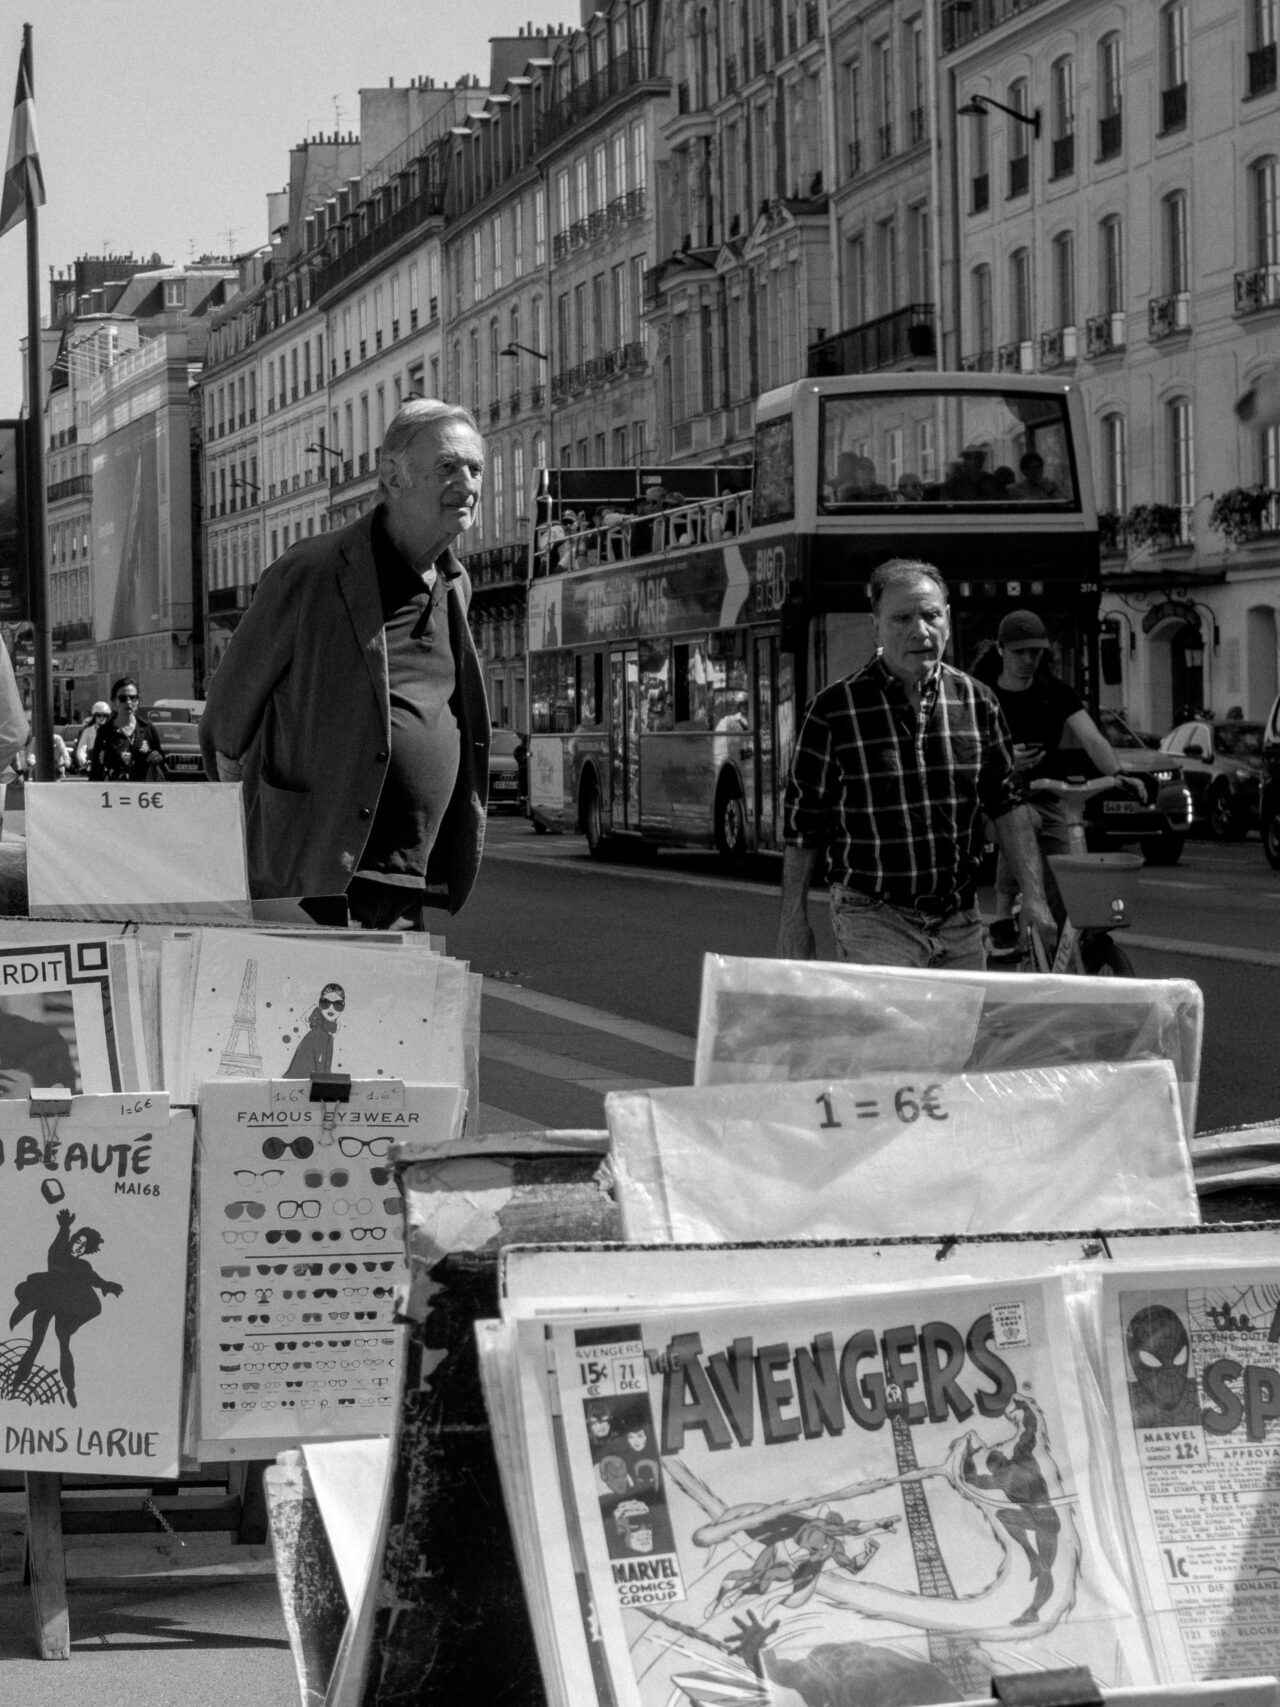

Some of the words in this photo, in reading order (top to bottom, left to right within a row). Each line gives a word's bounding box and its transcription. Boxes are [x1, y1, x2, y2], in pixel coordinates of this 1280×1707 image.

[1080, 583, 1098, 593] 374
[631, 577, 668, 629] PARIS
[101, 791, 113, 808] 1
[138, 791, 164, 809] 6€
[815, 1092, 842, 1129] 1
[894, 1084, 949, 1124] 6€
[237, 1111, 312, 1123] FAMOUS
[14, 1132, 153, 1178] BEAUTÉ
[1206, 1301, 1256, 1332] the
[576, 1343, 642, 1359] AVENGERS
[645, 1347, 683, 1375] THE
[580, 1362, 608, 1386] 15¢
[619, 1363, 636, 1380] 71
[620, 1380, 642, 1391] DEC
[662, 1313, 1017, 1456] AVENGERS
[1201, 1358, 1280, 1443] SP
[5, 1426, 69, 1455] DANS
[1143, 1430, 1197, 1444] MARVEL
[1175, 1442, 1200, 1461] 12¢
[1223, 1447, 1280, 1460] APPROVA
[1199, 1493, 1240, 1505] FREE
[611, 1557, 679, 1584] MARVEL
[618, 1580, 676, 1595] COMICS
[1234, 1580, 1280, 1593] BONANZ
[620, 1590, 677, 1605] GROUP
